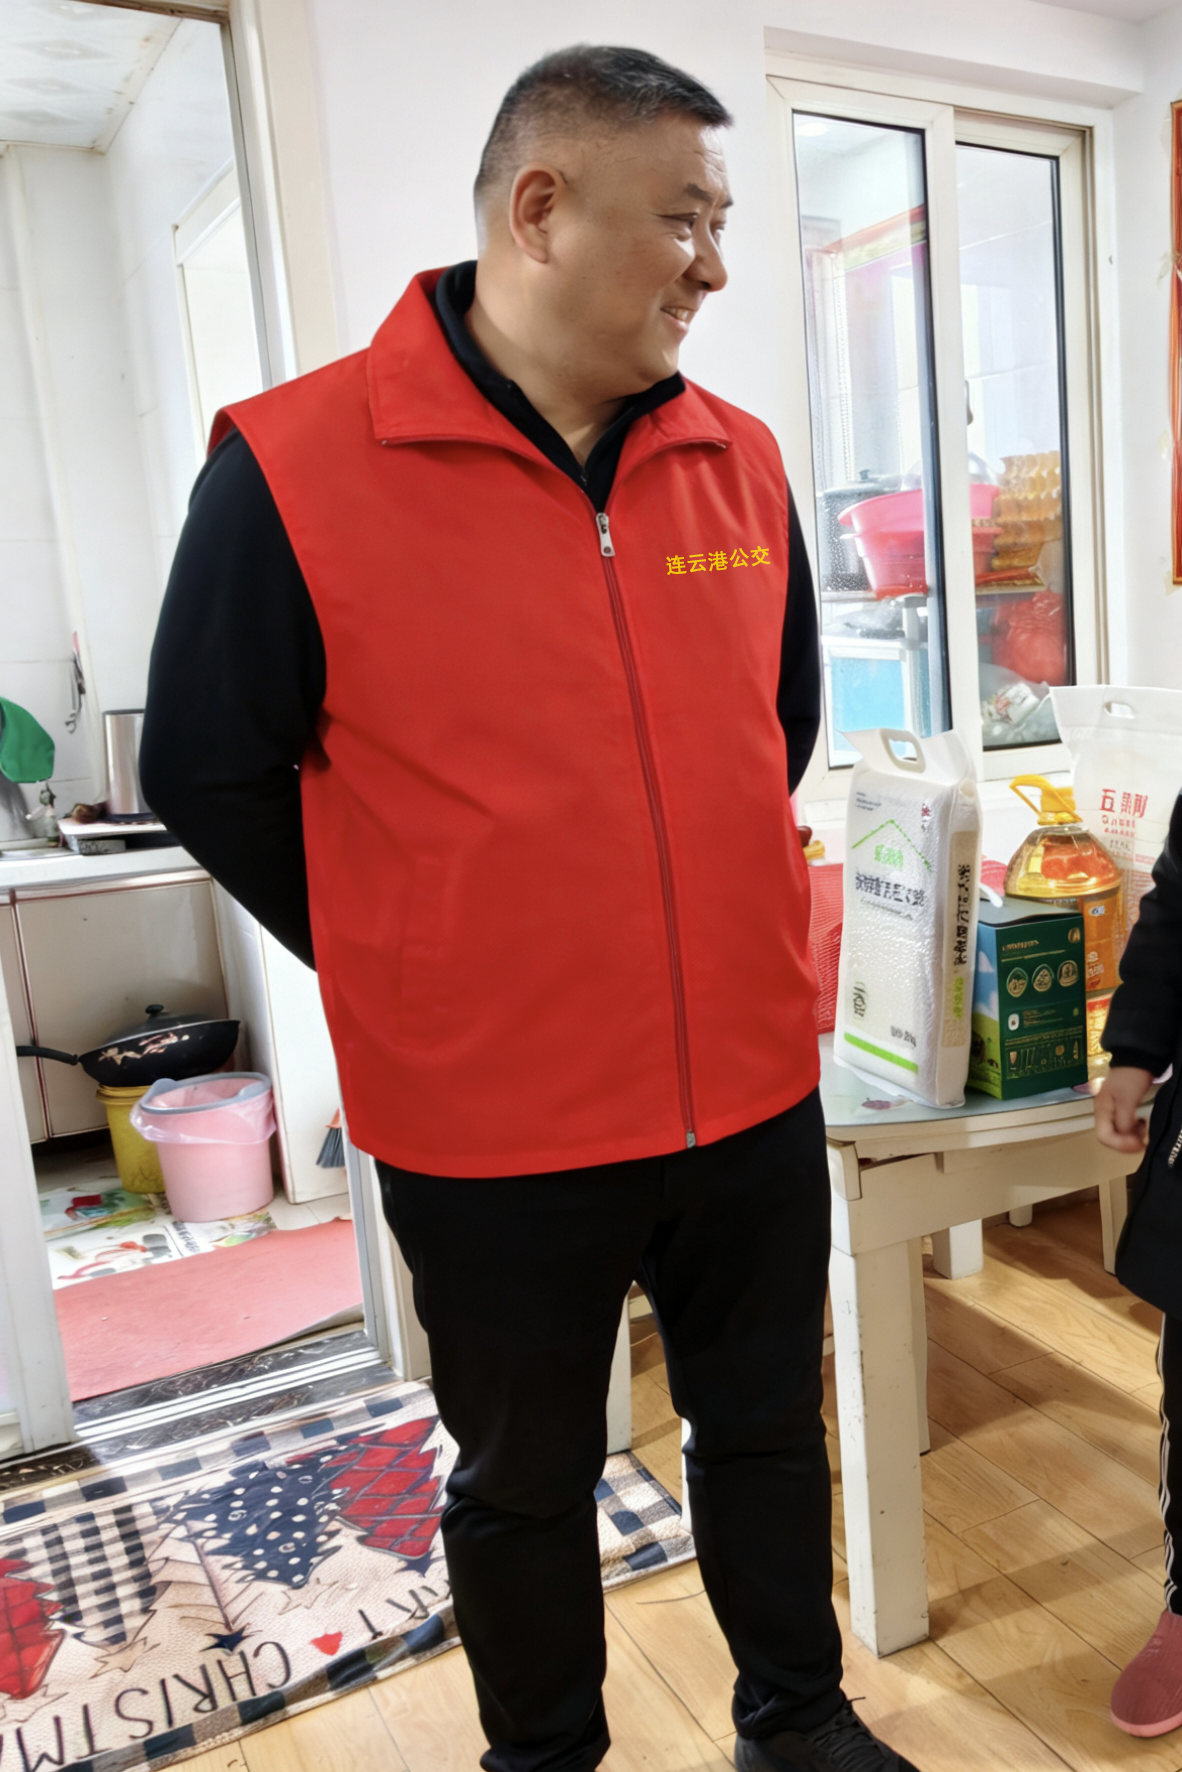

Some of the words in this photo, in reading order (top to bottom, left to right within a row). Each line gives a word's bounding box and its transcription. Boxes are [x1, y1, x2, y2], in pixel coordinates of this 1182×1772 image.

[665, 545, 771, 576] 连云港公交
[0, 1641, 291, 1772] CHRISTM
